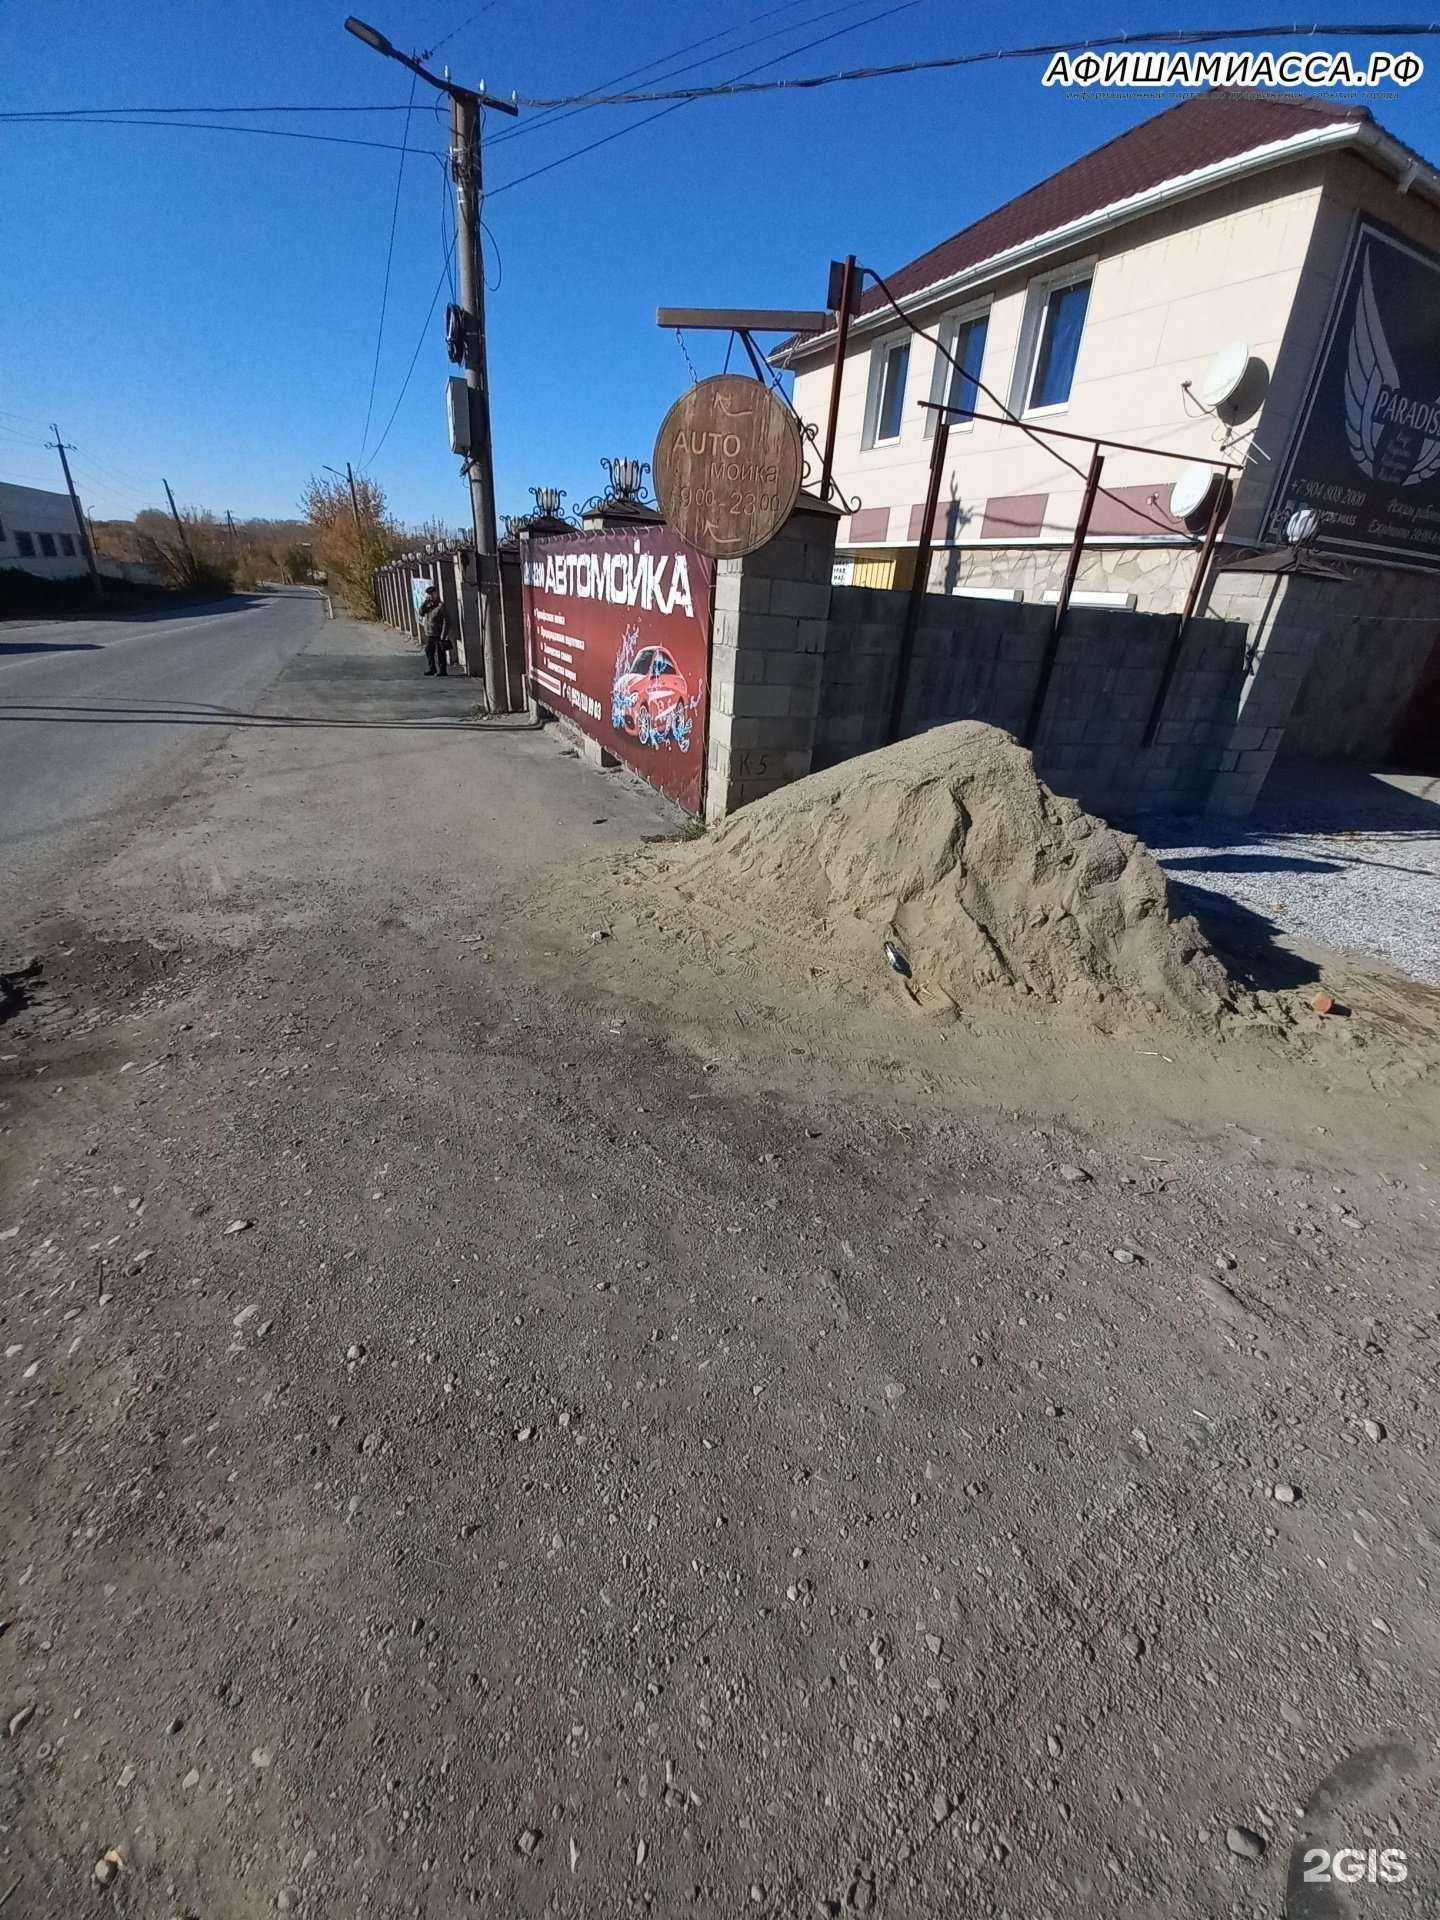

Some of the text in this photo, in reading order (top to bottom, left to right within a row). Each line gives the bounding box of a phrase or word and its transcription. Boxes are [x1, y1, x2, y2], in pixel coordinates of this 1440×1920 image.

[1374, 390, 1440, 436] PARADIS
[672, 430, 741, 458] AUTO
[544, 538, 695, 617] АВТОМОЙКА
